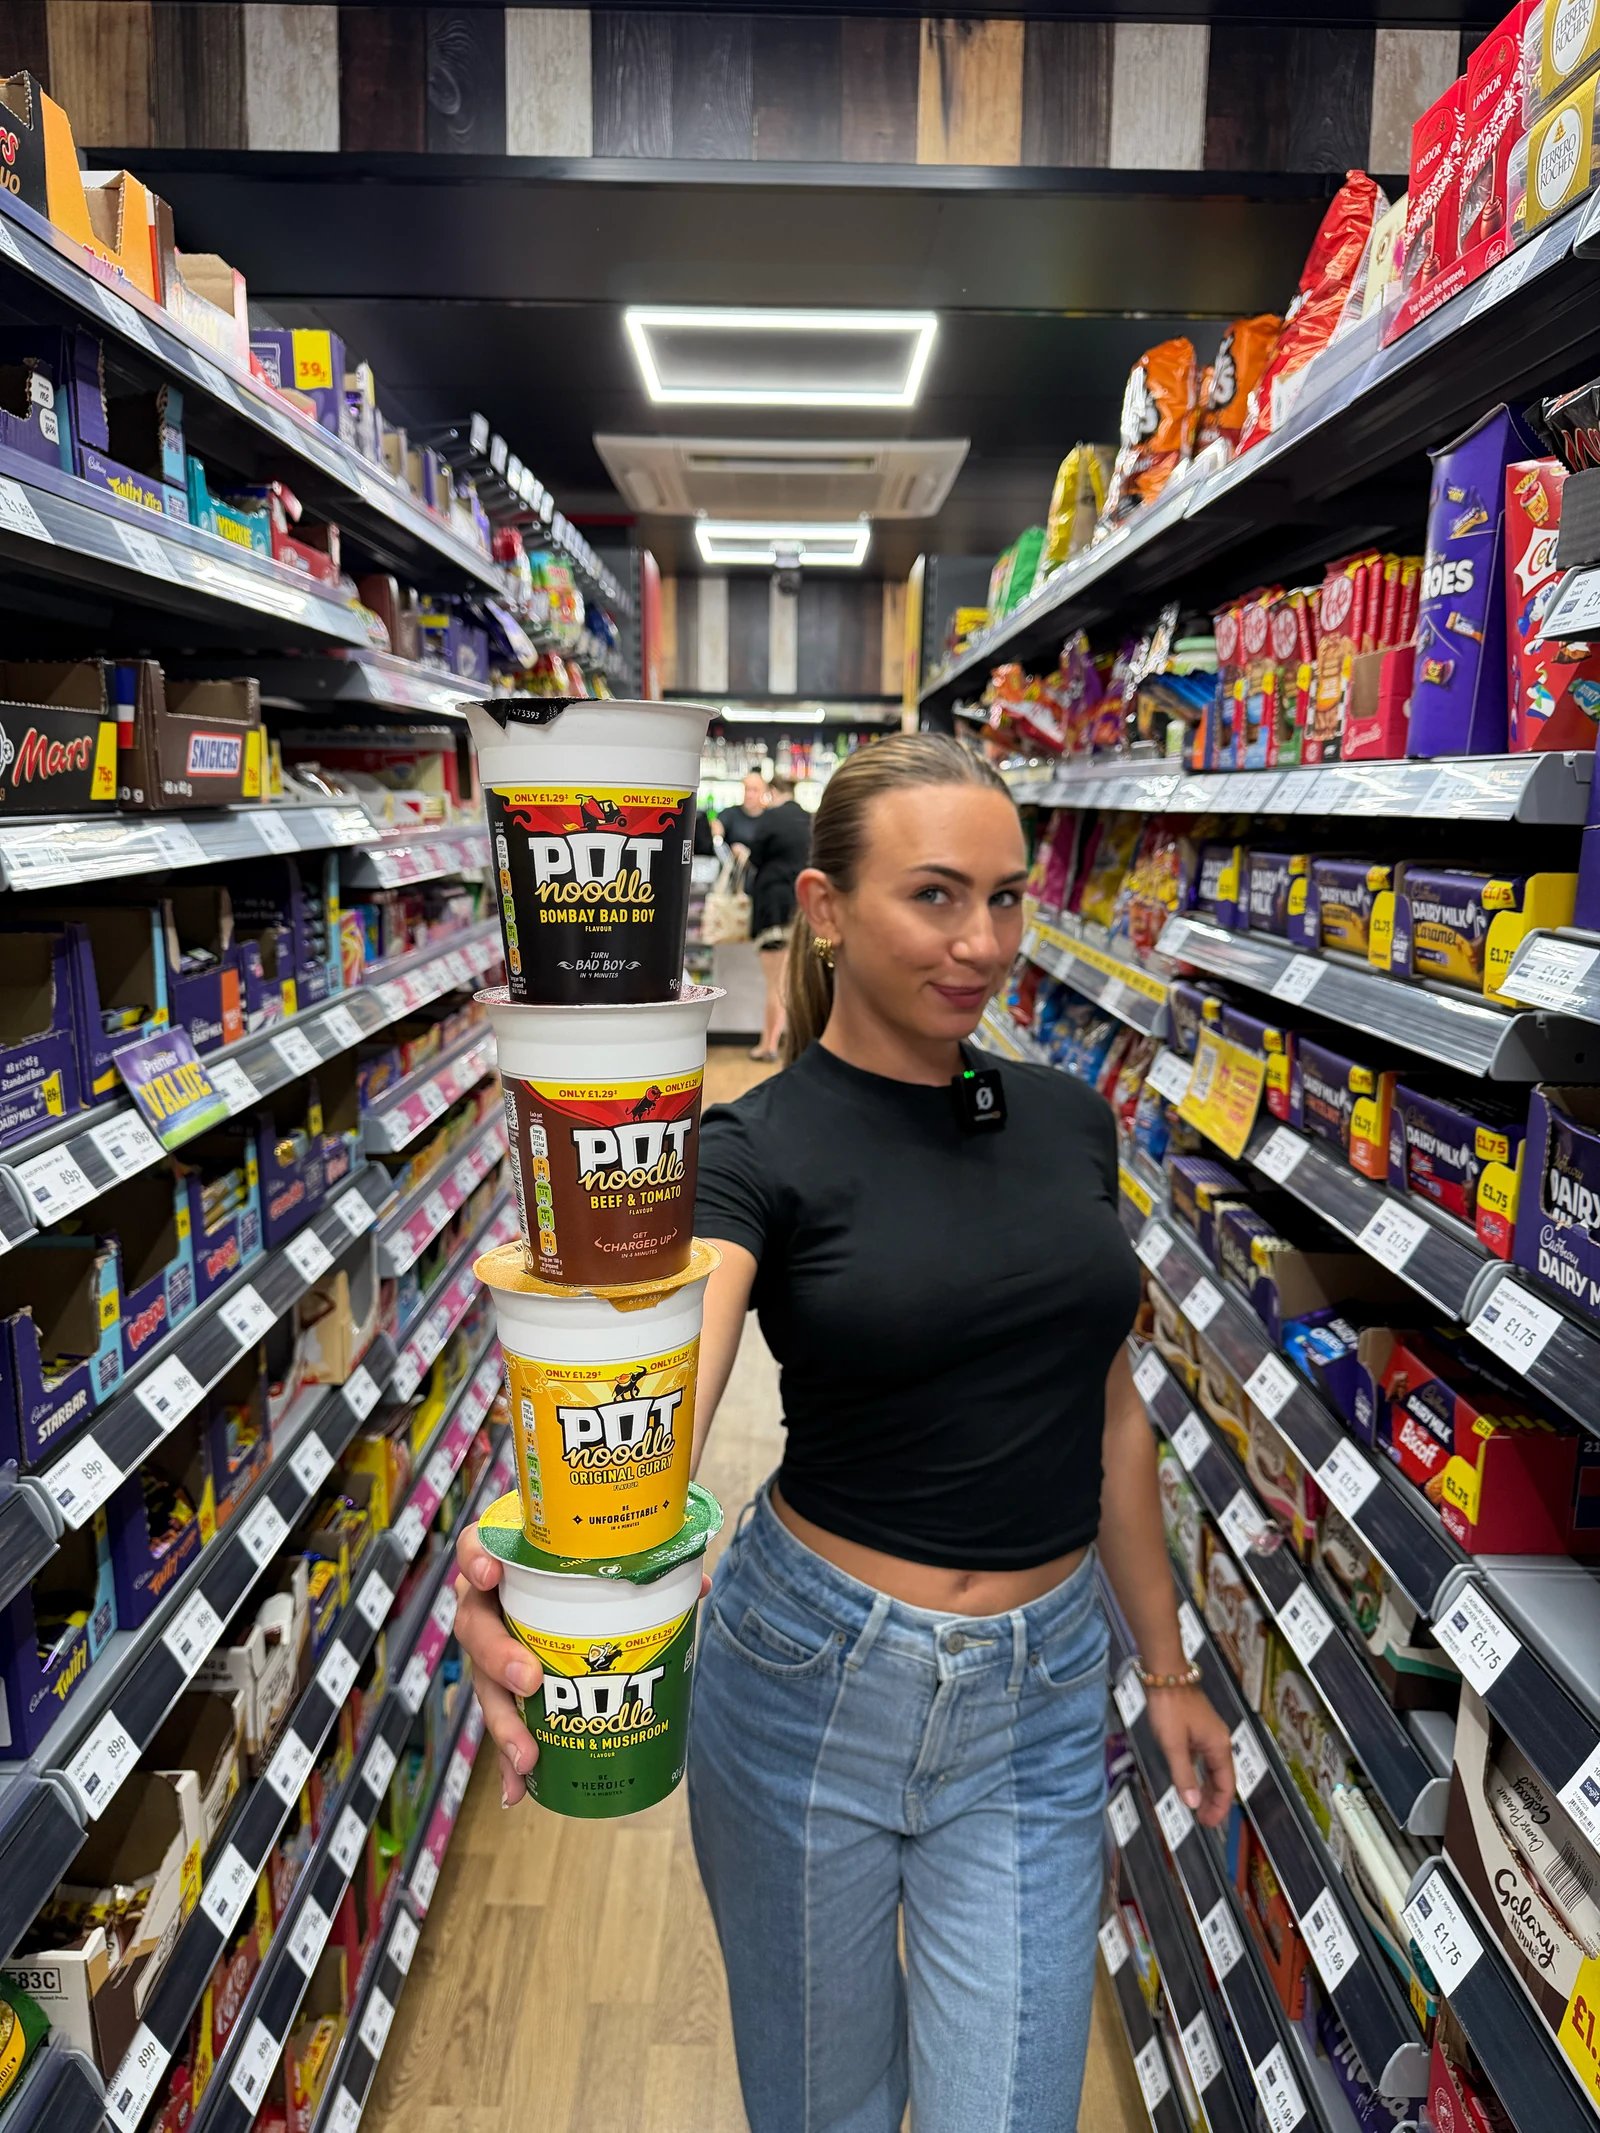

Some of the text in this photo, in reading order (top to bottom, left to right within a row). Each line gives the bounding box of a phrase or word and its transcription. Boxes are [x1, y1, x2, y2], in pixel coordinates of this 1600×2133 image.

[1555, 10, 1590, 55] ROCHER
[1472, 74, 1502, 111] LINDOR
[1416, 142, 1442, 174] LINDOR
[1541, 133, 1576, 173] FERRERO
[1540, 150, 1575, 190] ROCHER
[217, 515, 253, 548] YORKIE
[12, 727, 92, 787] Mars
[191, 739, 239, 769] SNICKERS
[514, 793, 538, 803] ONLY
[623, 794, 650, 805] ONLY
[528, 833, 663, 888] POT
[535, 869, 655, 903] noodle
[540, 909, 655, 923] BOMBAY BAD BOY
[1413, 900, 1467, 928] DAIRY MILK
[1415, 921, 1457, 945] Caramel
[575, 960, 626, 971] BAD BOY
[2, 1067, 45, 1091] Standard Bars
[138, 1062, 212, 1120] VALUE
[559, 1090, 586, 1098] ONLY
[665, 1083, 684, 1093] ONLY
[18, 1107, 37, 1123] MILK
[131, 1129, 150, 1145] 89p
[573, 1119, 692, 1176] POT
[1407, 1125, 1436, 1154] DAIRY
[1436, 1139, 1463, 1170] MILK
[1477, 1134, 1506, 1154] £1.75
[59, 1168, 81, 1185] 89p
[578, 1150, 685, 1191] noodle
[590, 1185, 681, 1209] BEEF & TOMATO
[629, 1207, 653, 1215] FLAVOUR
[1483, 1184, 1508, 1208] £1.75
[603, 1234, 672, 1253] CHARGED UP
[632, 1231, 648, 1239] GET
[1540, 1224, 1579, 1269] Cadbury
[634, 1249, 658, 1258] MINUTES
[1538, 1247, 1588, 1298] DAIRY
[1504, 1318, 1537, 1347] £1.75
[546, 1369, 571, 1378] ONLY
[650, 1358, 672, 1371] ONLY
[174, 1374, 191, 1391] 89p
[37, 1389, 88, 1445] STARBAR
[559, 1390, 683, 1450] POT
[564, 1426, 675, 1468] noodle
[1399, 1418, 1440, 1469] Biscoff
[81, 1460, 103, 1480] 89p
[570, 1454, 674, 1486] ORIGINAL CURRY
[589, 1505, 658, 1525] UNFORGETTABLE
[527, 1634, 548, 1647] ONLY
[625, 1636, 651, 1649] ONLY
[1471, 1633, 1501, 1670] £1.75
[52, 1640, 87, 1701] Twirl
[543, 1666, 665, 1715] POT
[545, 1700, 657, 1736] noodle
[108, 1735, 126, 1758] 89p
[536, 1719, 669, 1750] CHICKEN & MUSHROOM
[581, 1780, 626, 1790] HEROIC
[1519, 1823, 1544, 1853] Choose
[1495, 1869, 1556, 1974] Galaxy
[1509, 1913, 1539, 1959] Ripple
[1434, 1922, 1462, 1966] £1.75
[1572, 1995, 1600, 2068] £1.
[138, 2042, 156, 2069] 89p
